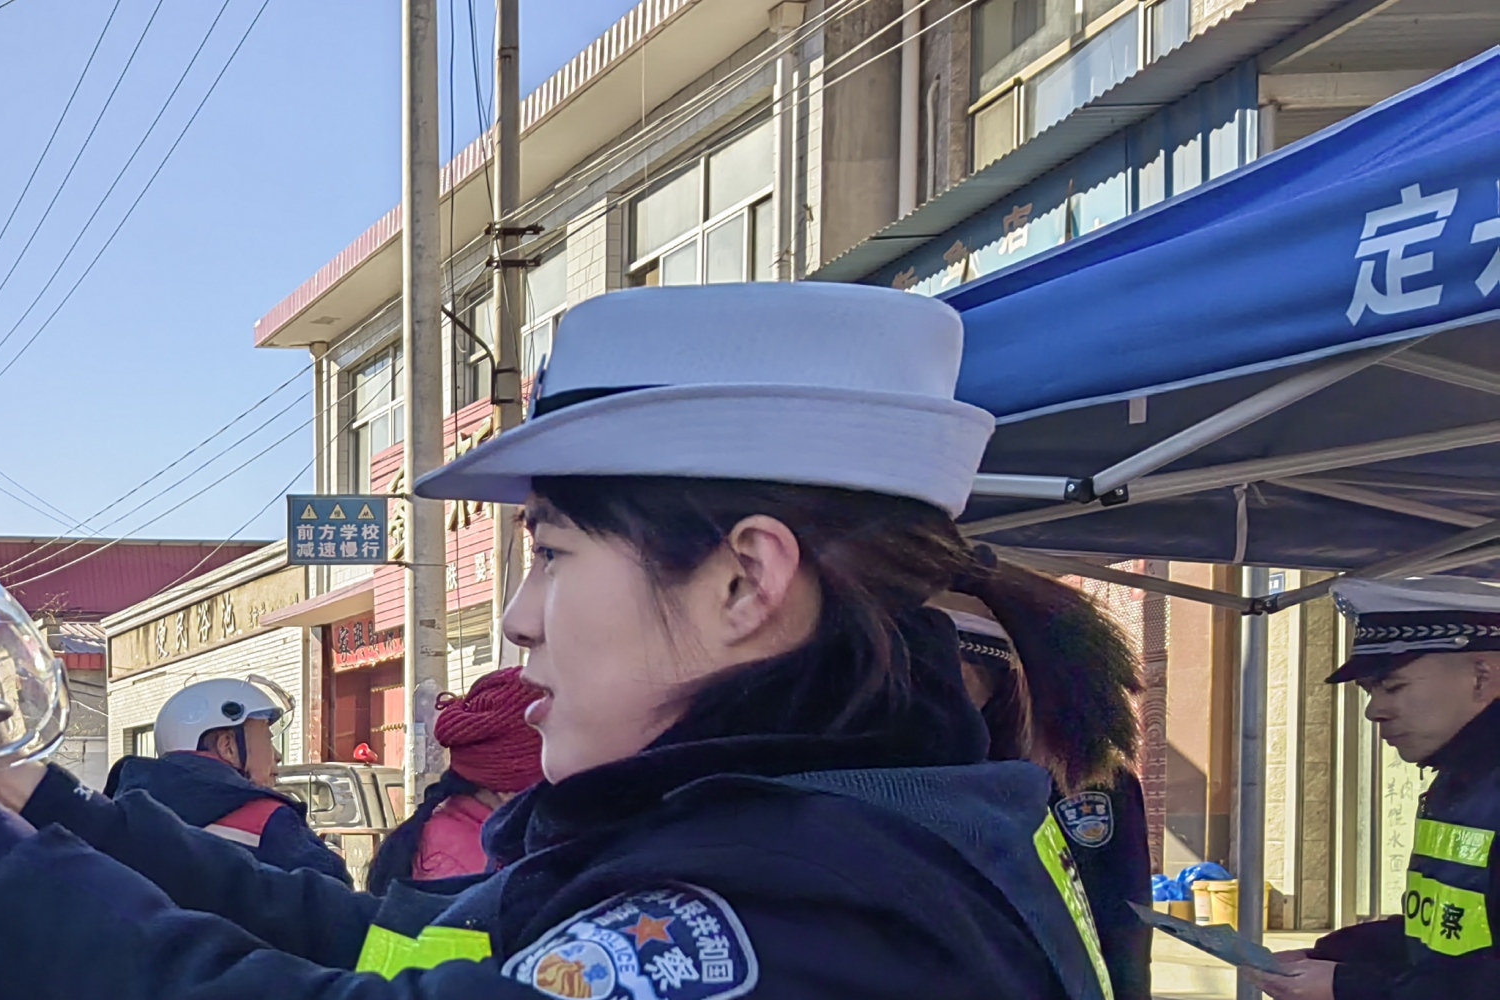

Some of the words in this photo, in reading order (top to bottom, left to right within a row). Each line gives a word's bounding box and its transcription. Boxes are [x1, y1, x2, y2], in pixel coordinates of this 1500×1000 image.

[296, 523, 380, 541] 前方学校
[296, 541, 380, 559] 减速慢行
[156, 592, 237, 660] 便民浴池
